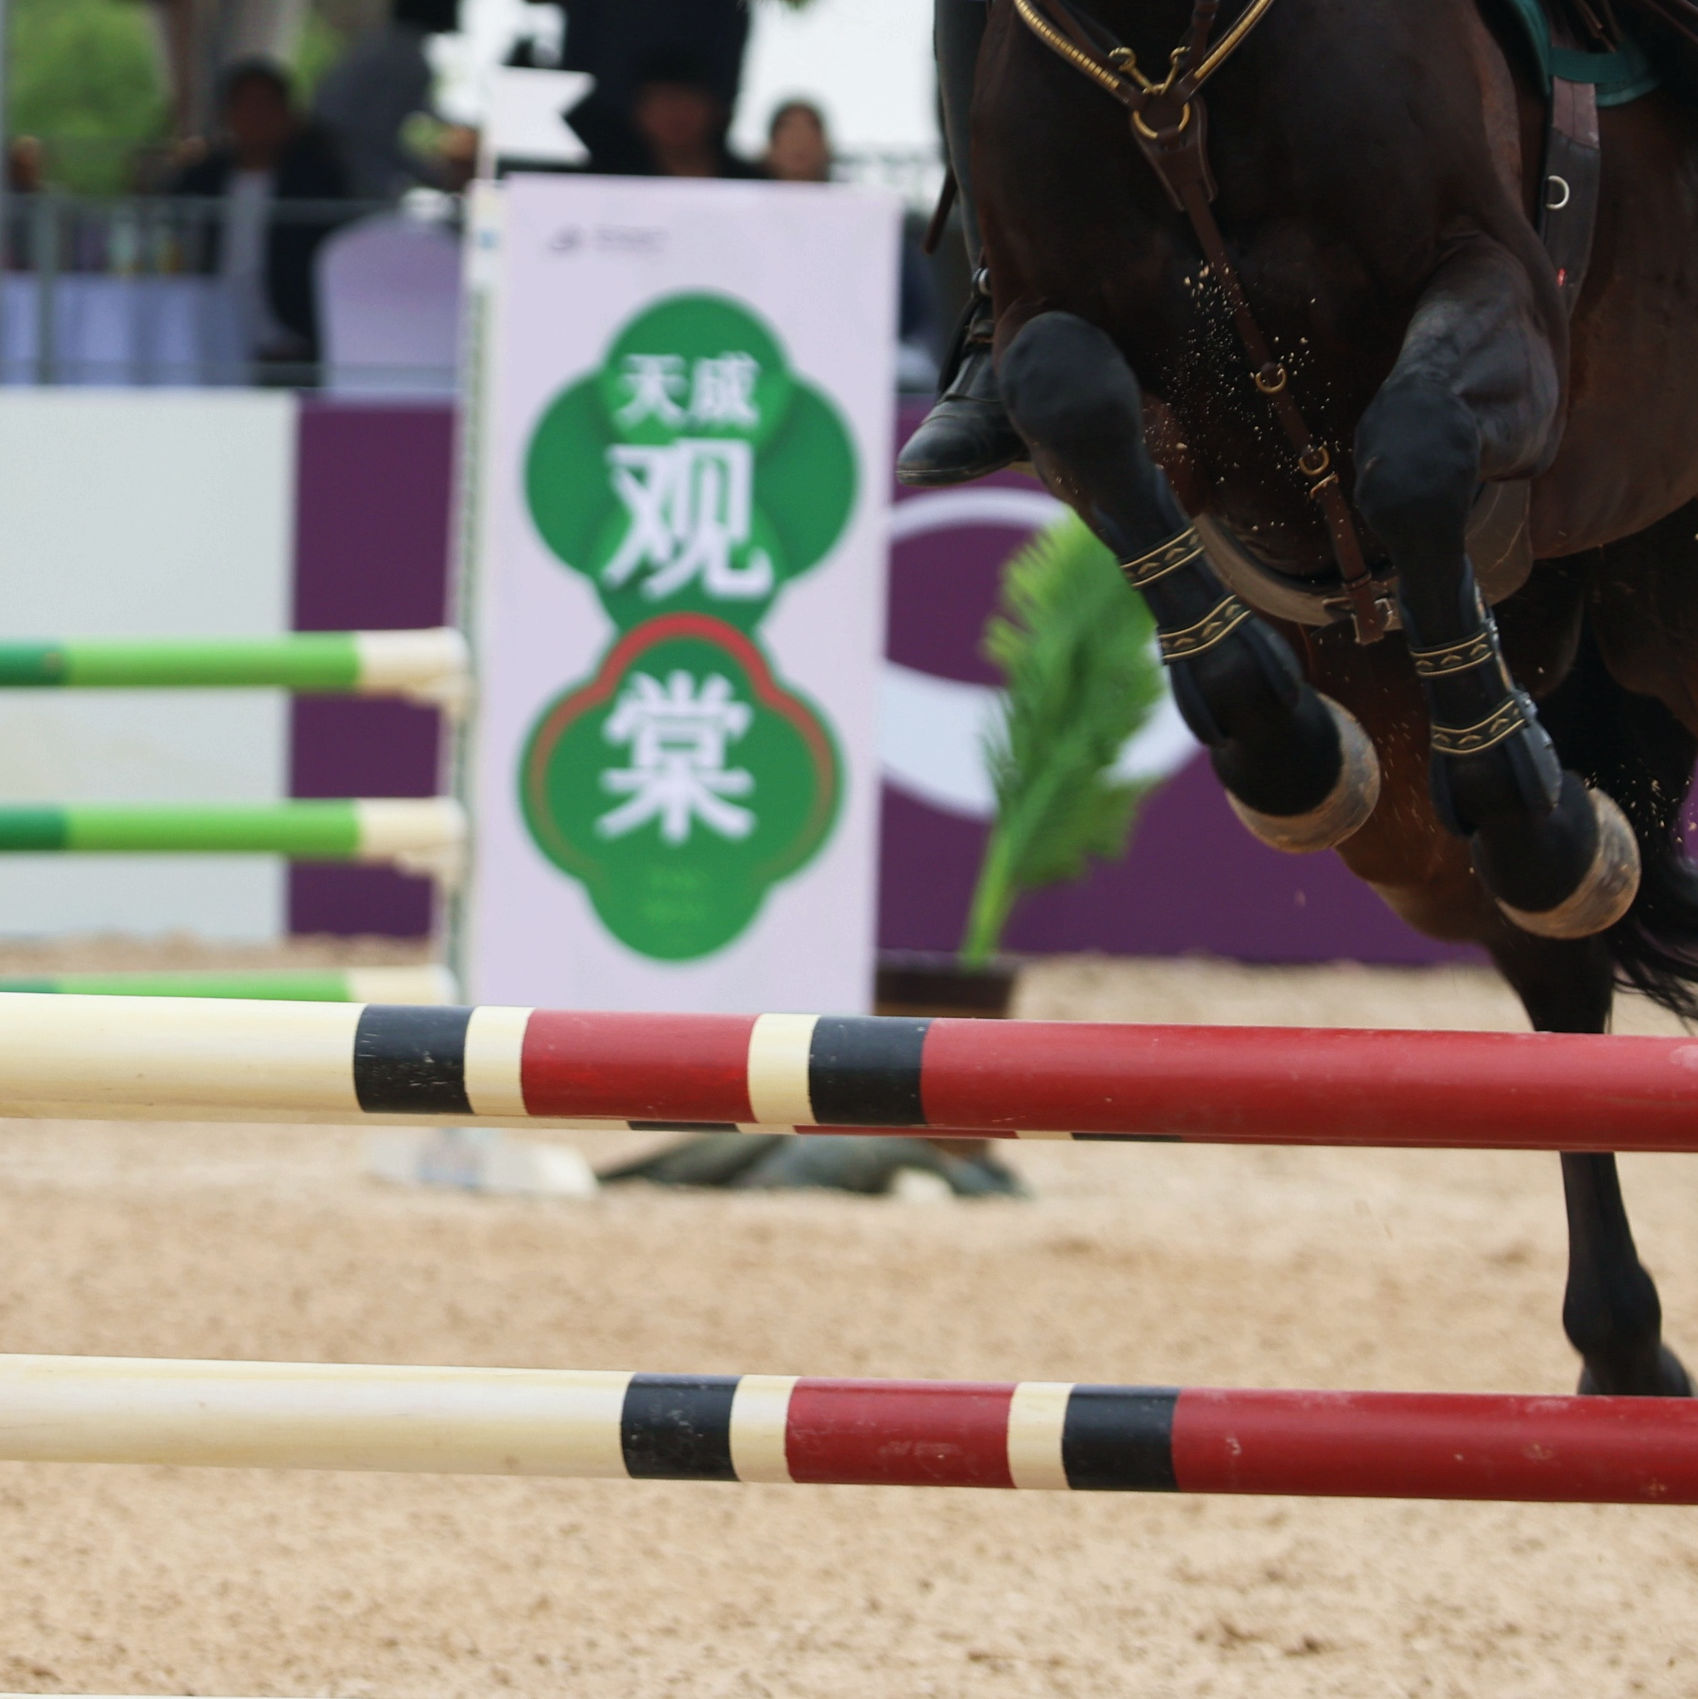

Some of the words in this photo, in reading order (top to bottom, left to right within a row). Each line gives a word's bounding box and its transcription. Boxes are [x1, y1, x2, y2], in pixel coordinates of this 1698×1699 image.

[618, 350, 761, 430] 天成
[602, 435, 776, 600] 观
[597, 670, 756, 844] 棠
